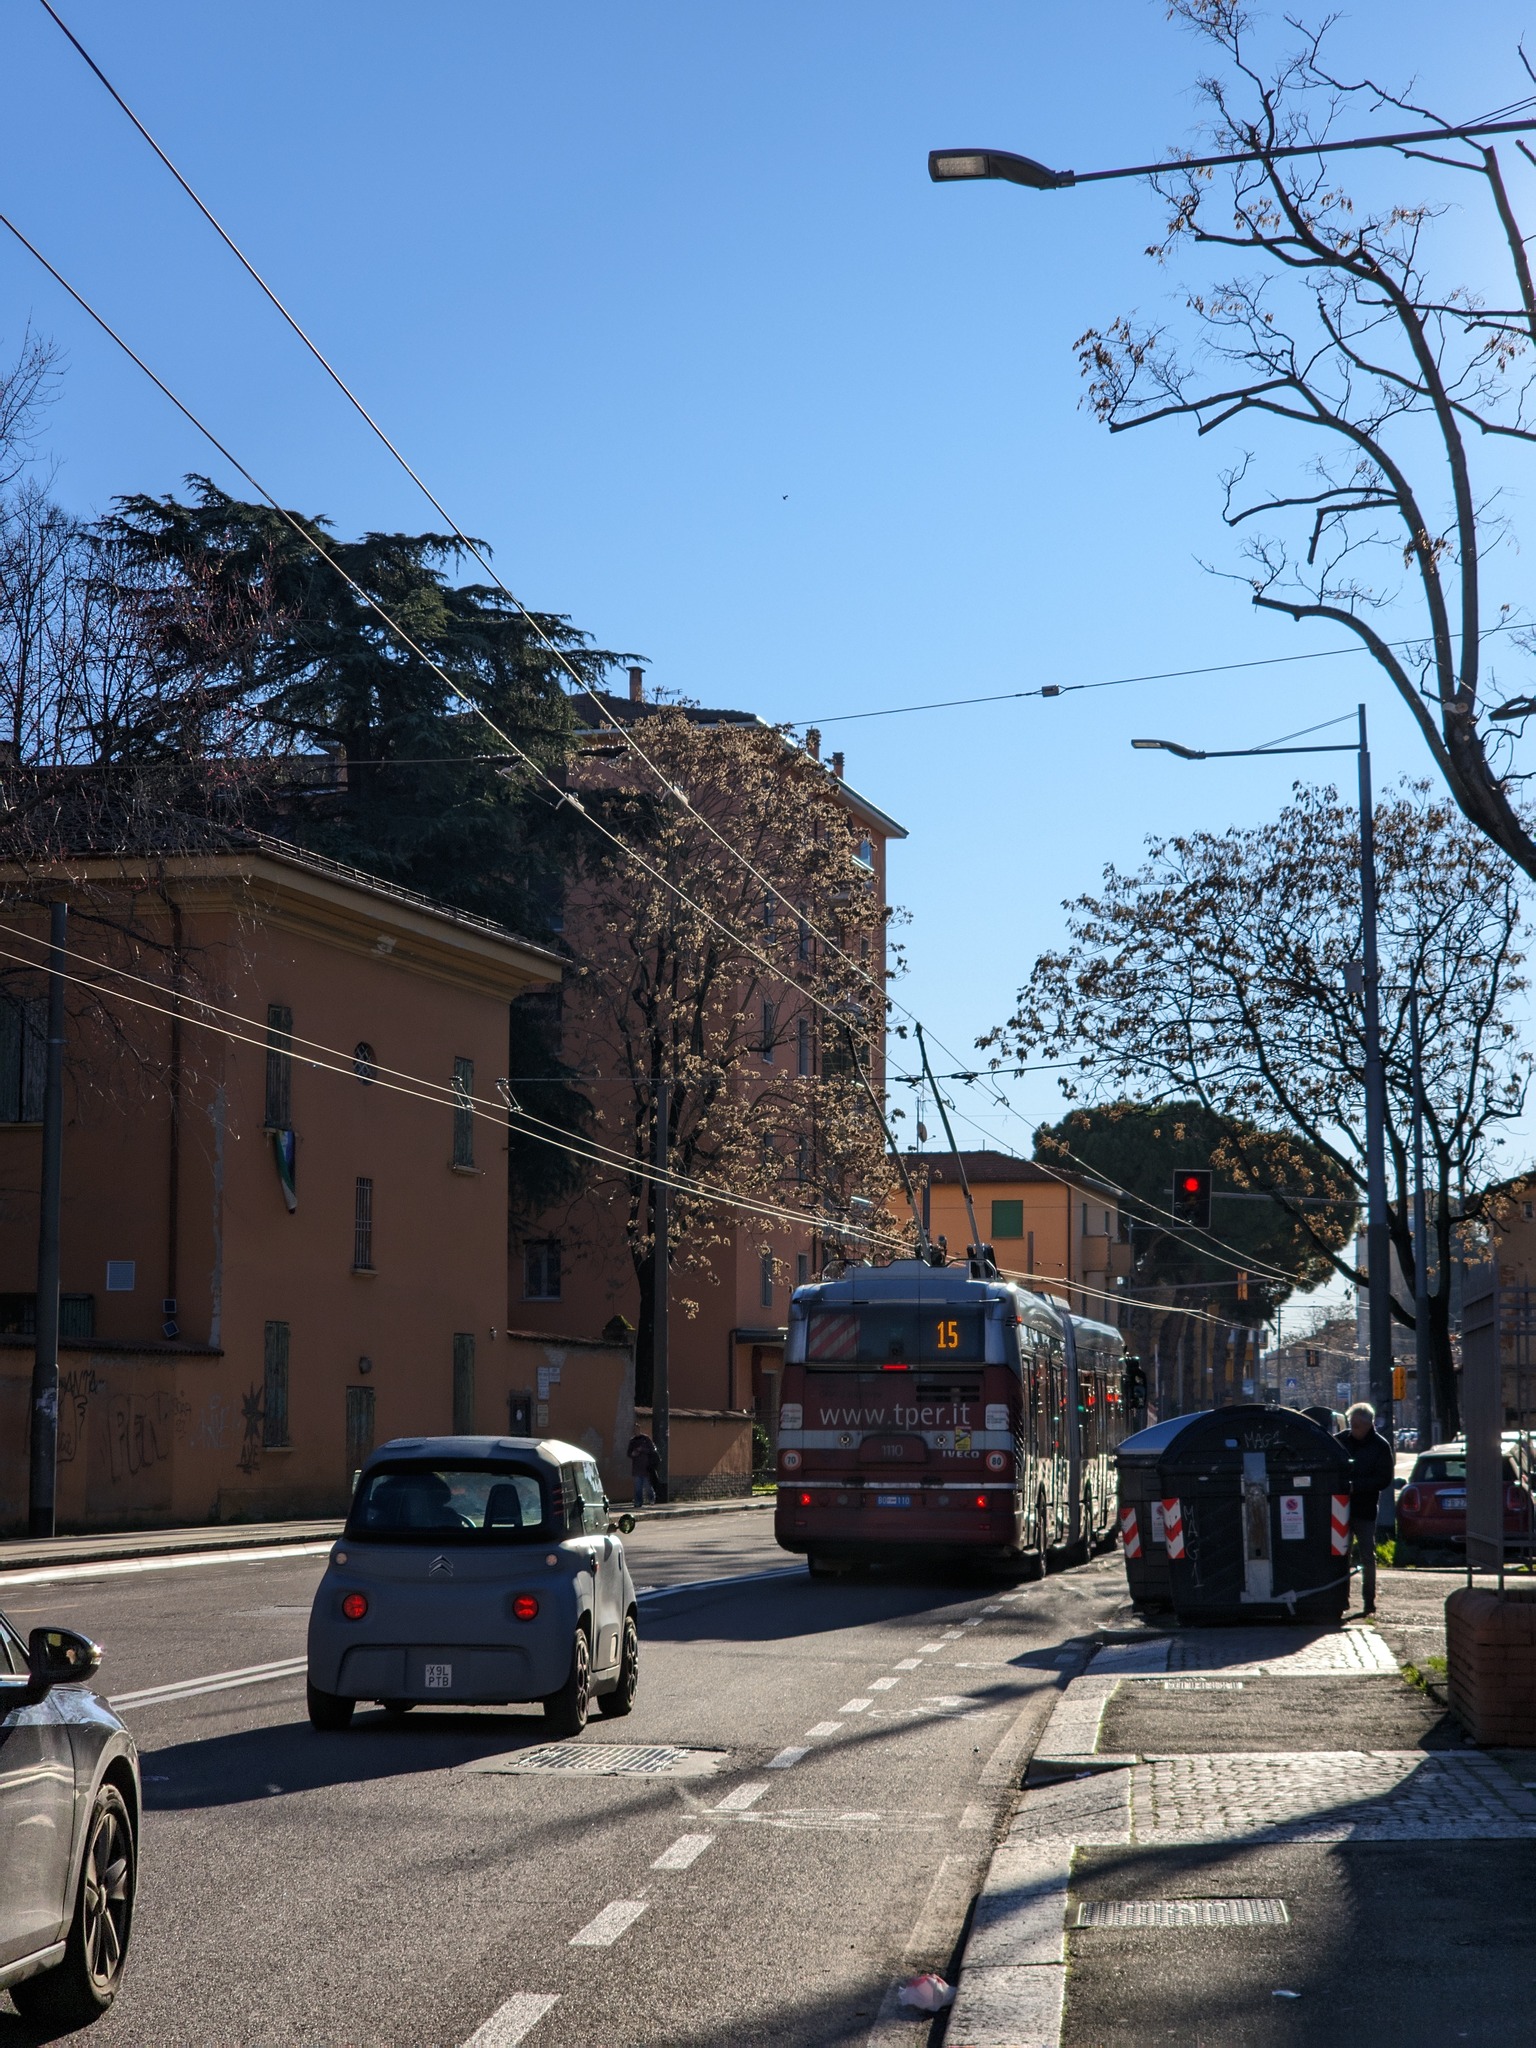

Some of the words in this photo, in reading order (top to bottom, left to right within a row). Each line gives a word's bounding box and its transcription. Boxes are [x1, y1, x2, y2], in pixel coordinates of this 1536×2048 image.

[937, 1320, 958, 1349] 15
[819, 1403, 971, 1431] www.tper.it
[881, 1444, 904, 1457] 1110
[941, 1450, 980, 1458] IVECO
[786, 1455, 797, 1465] 70
[991, 1456, 1002, 1466] 80
[430, 1666, 448, 1675] X9L
[429, 1677, 448, 1686] PTB
